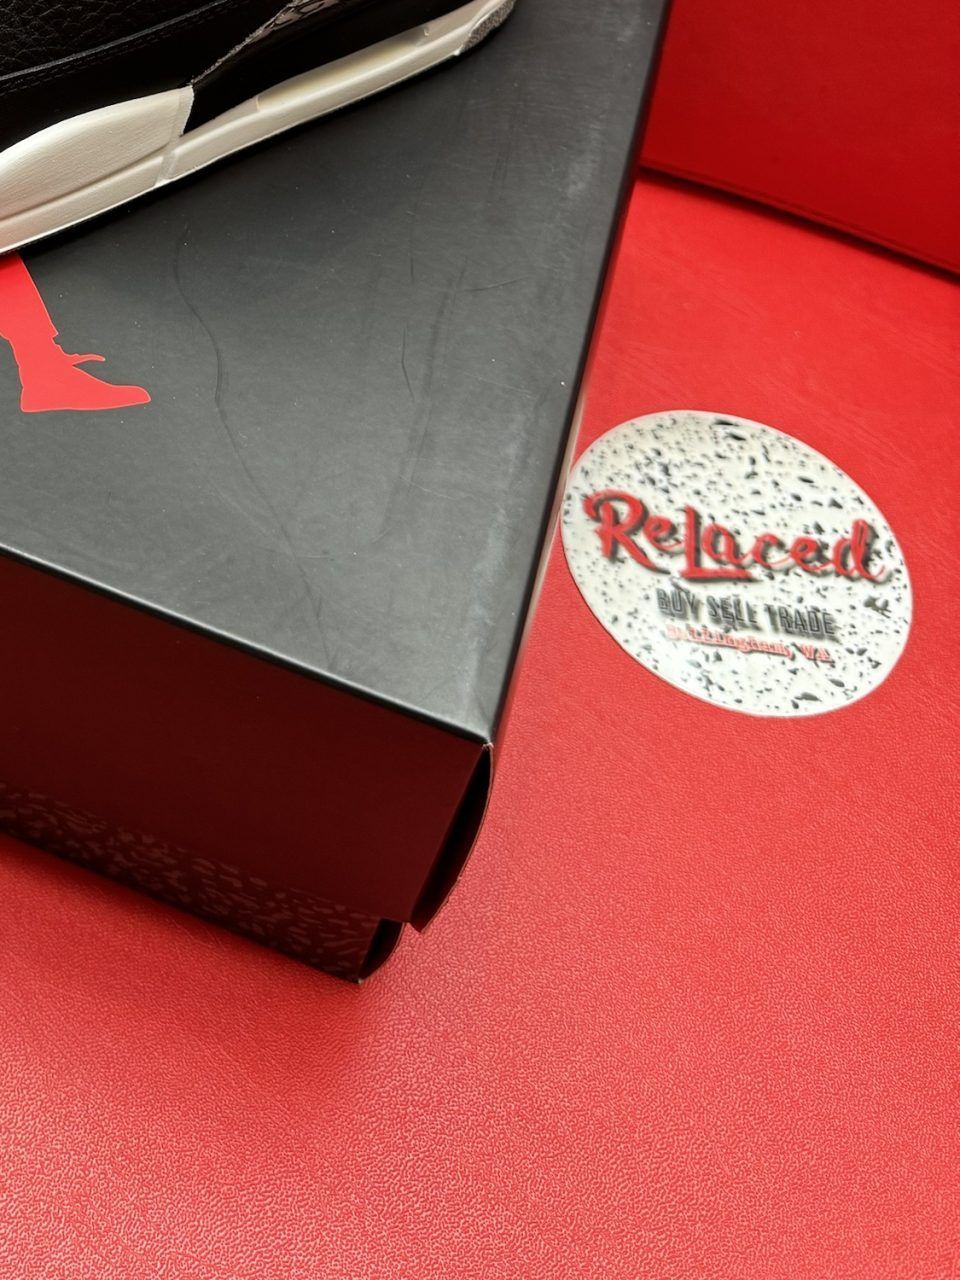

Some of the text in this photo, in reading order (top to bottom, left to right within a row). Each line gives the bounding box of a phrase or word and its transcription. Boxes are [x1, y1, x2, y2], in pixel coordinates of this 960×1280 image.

[656, 588, 838, 641] BUY SELL TRADE
